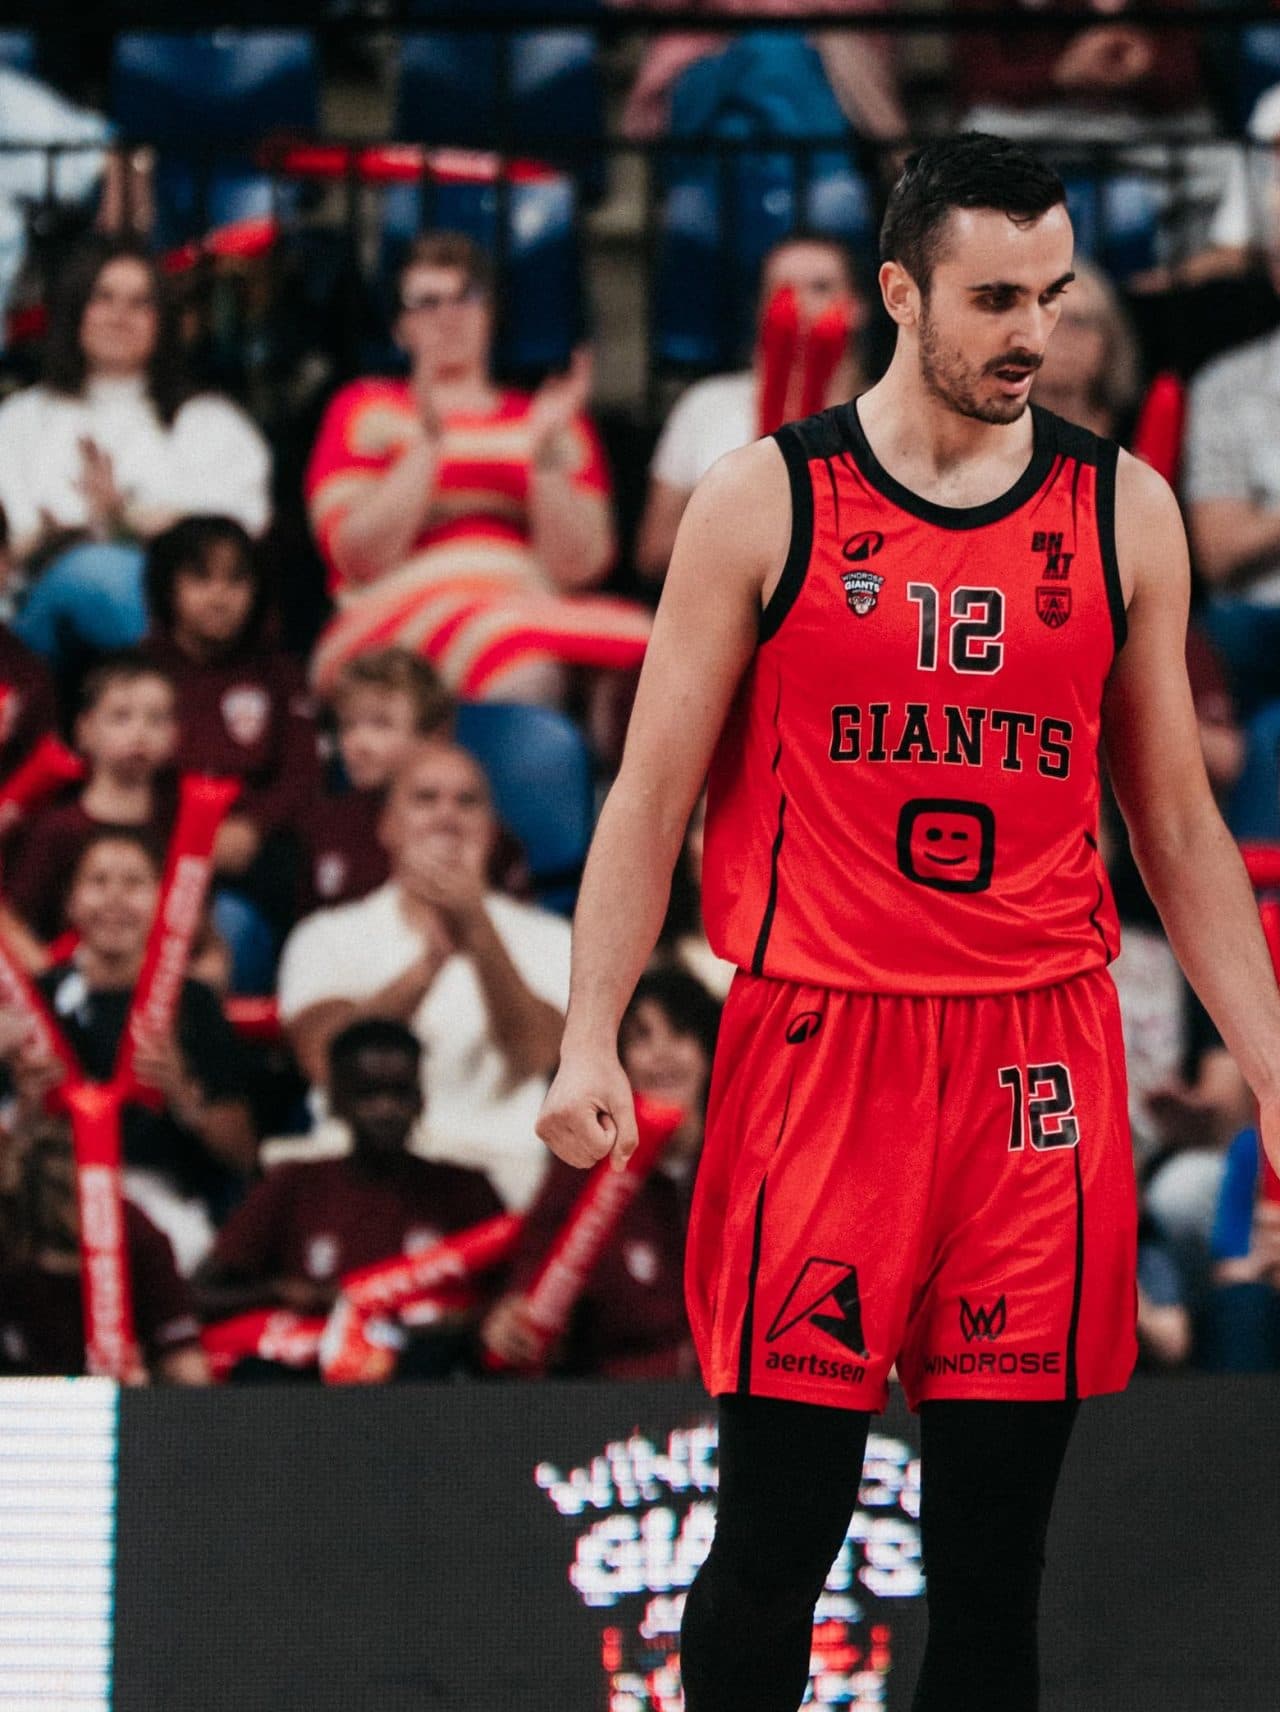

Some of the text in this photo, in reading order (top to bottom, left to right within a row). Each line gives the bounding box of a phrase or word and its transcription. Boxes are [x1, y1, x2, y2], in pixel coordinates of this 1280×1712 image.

[844, 580, 881, 593] GIANTS
[907, 582, 1005, 675] 12
[829, 702, 1073, 780] GIANTS
[998, 1061, 1079, 1152] 12
[765, 1351, 866, 1384] aertssen
[925, 1352, 1061, 1376] WINDROSE
